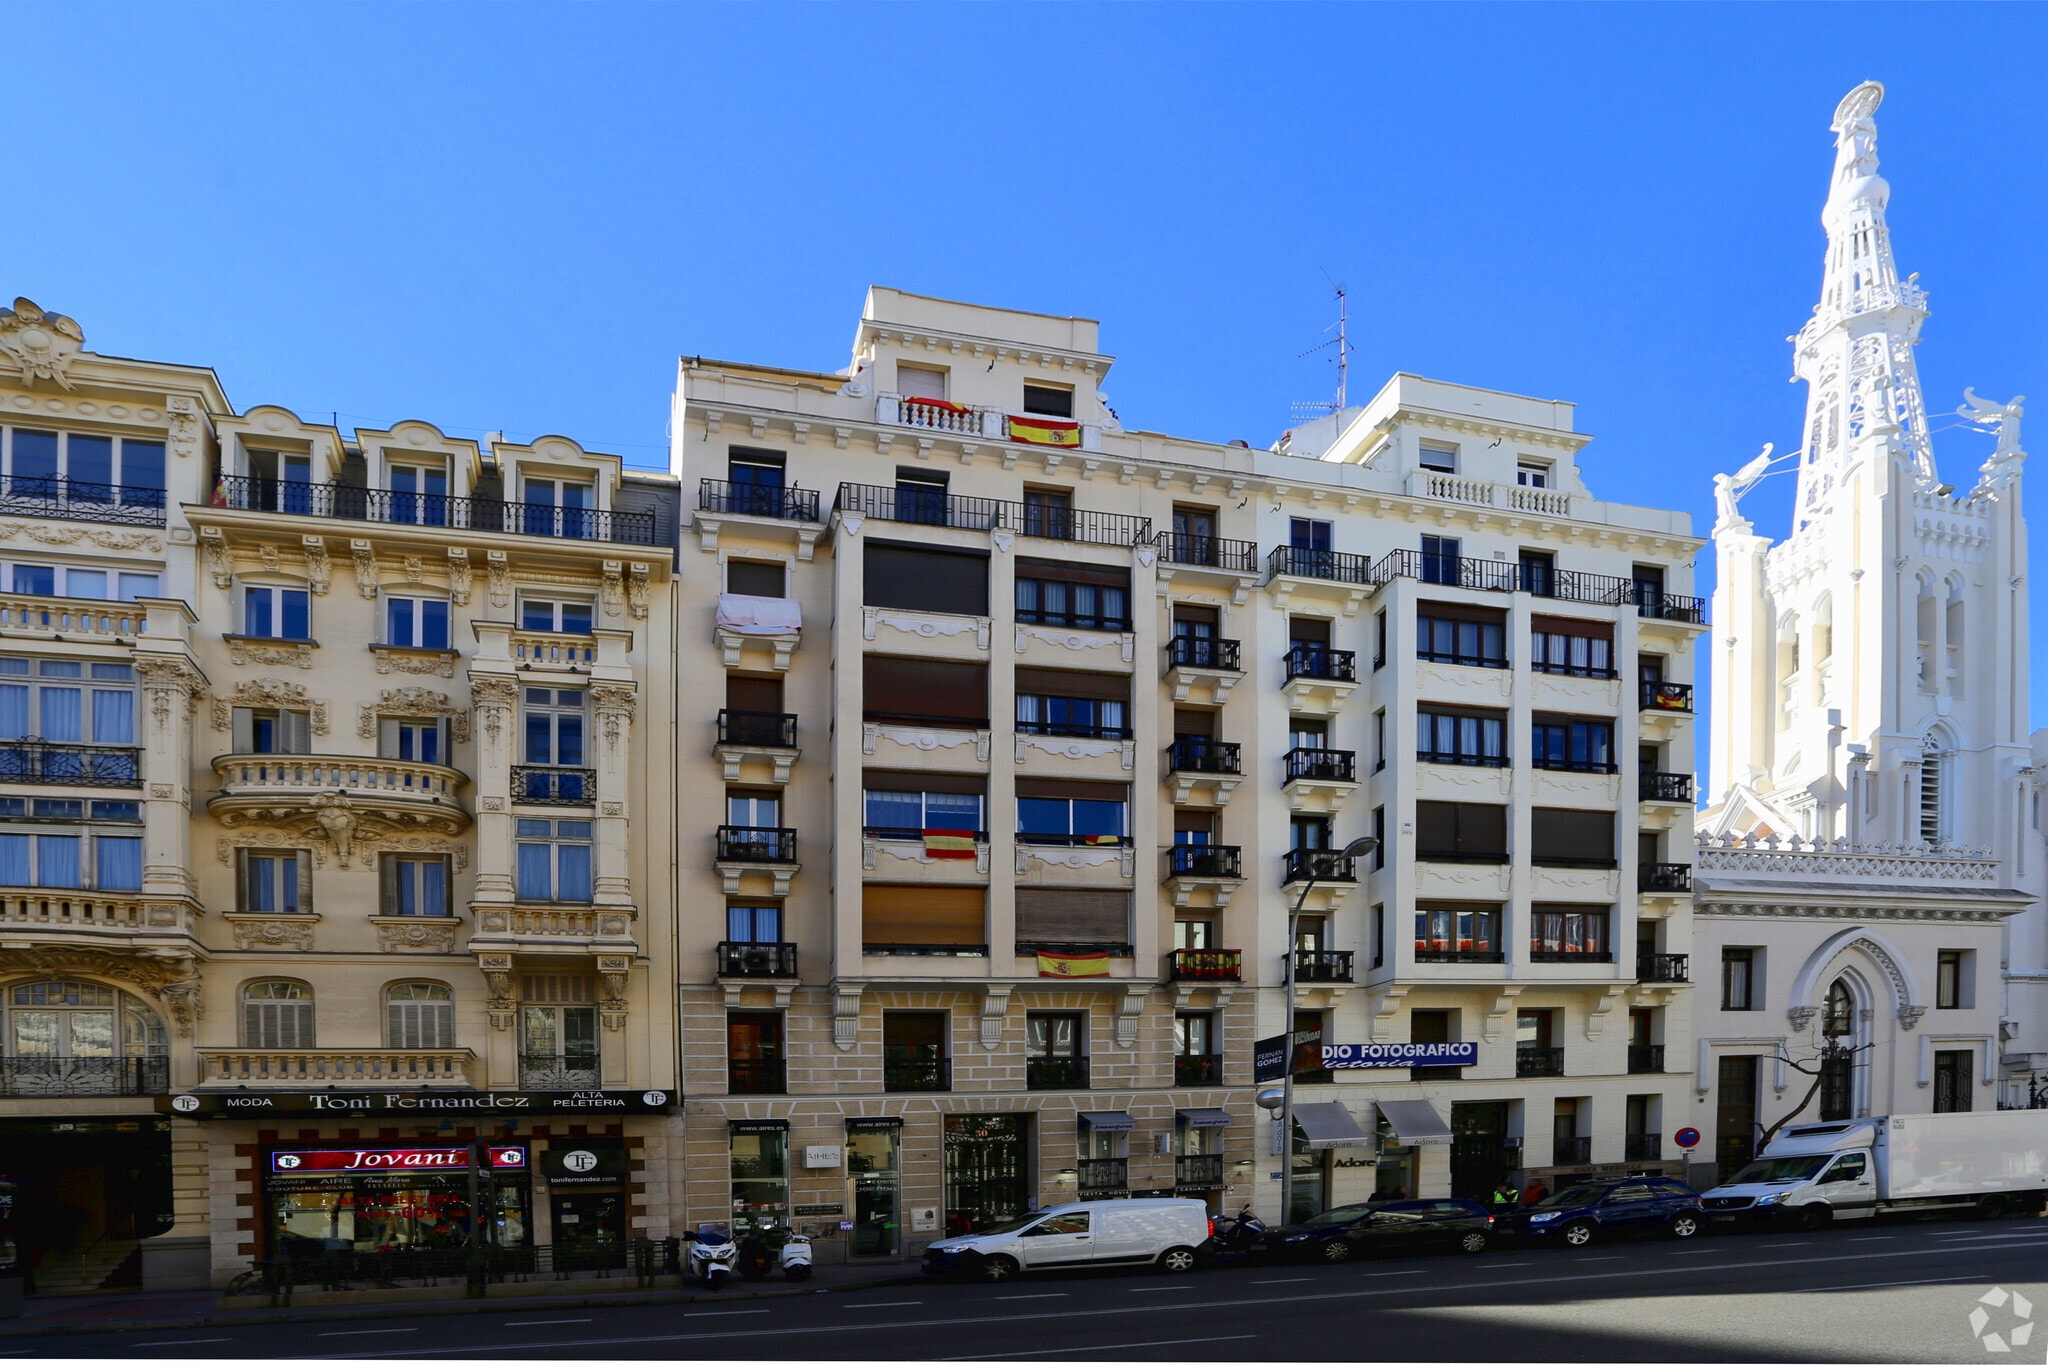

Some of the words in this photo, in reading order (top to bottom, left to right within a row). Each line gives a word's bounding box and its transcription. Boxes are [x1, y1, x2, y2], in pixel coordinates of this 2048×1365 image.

[1361, 1043, 1472, 1058] FOTOGRAFICO
[572, 1091, 604, 1099] ALTA
[227, 1098, 273, 1107] MODA
[309, 1094, 371, 1109] Toni
[384, 1093, 529, 1109] Fernandez
[553, 1099, 626, 1107] PELETERIA
[344, 1150, 457, 1169] Jovani
[1334, 1158, 1376, 1168] Adore
